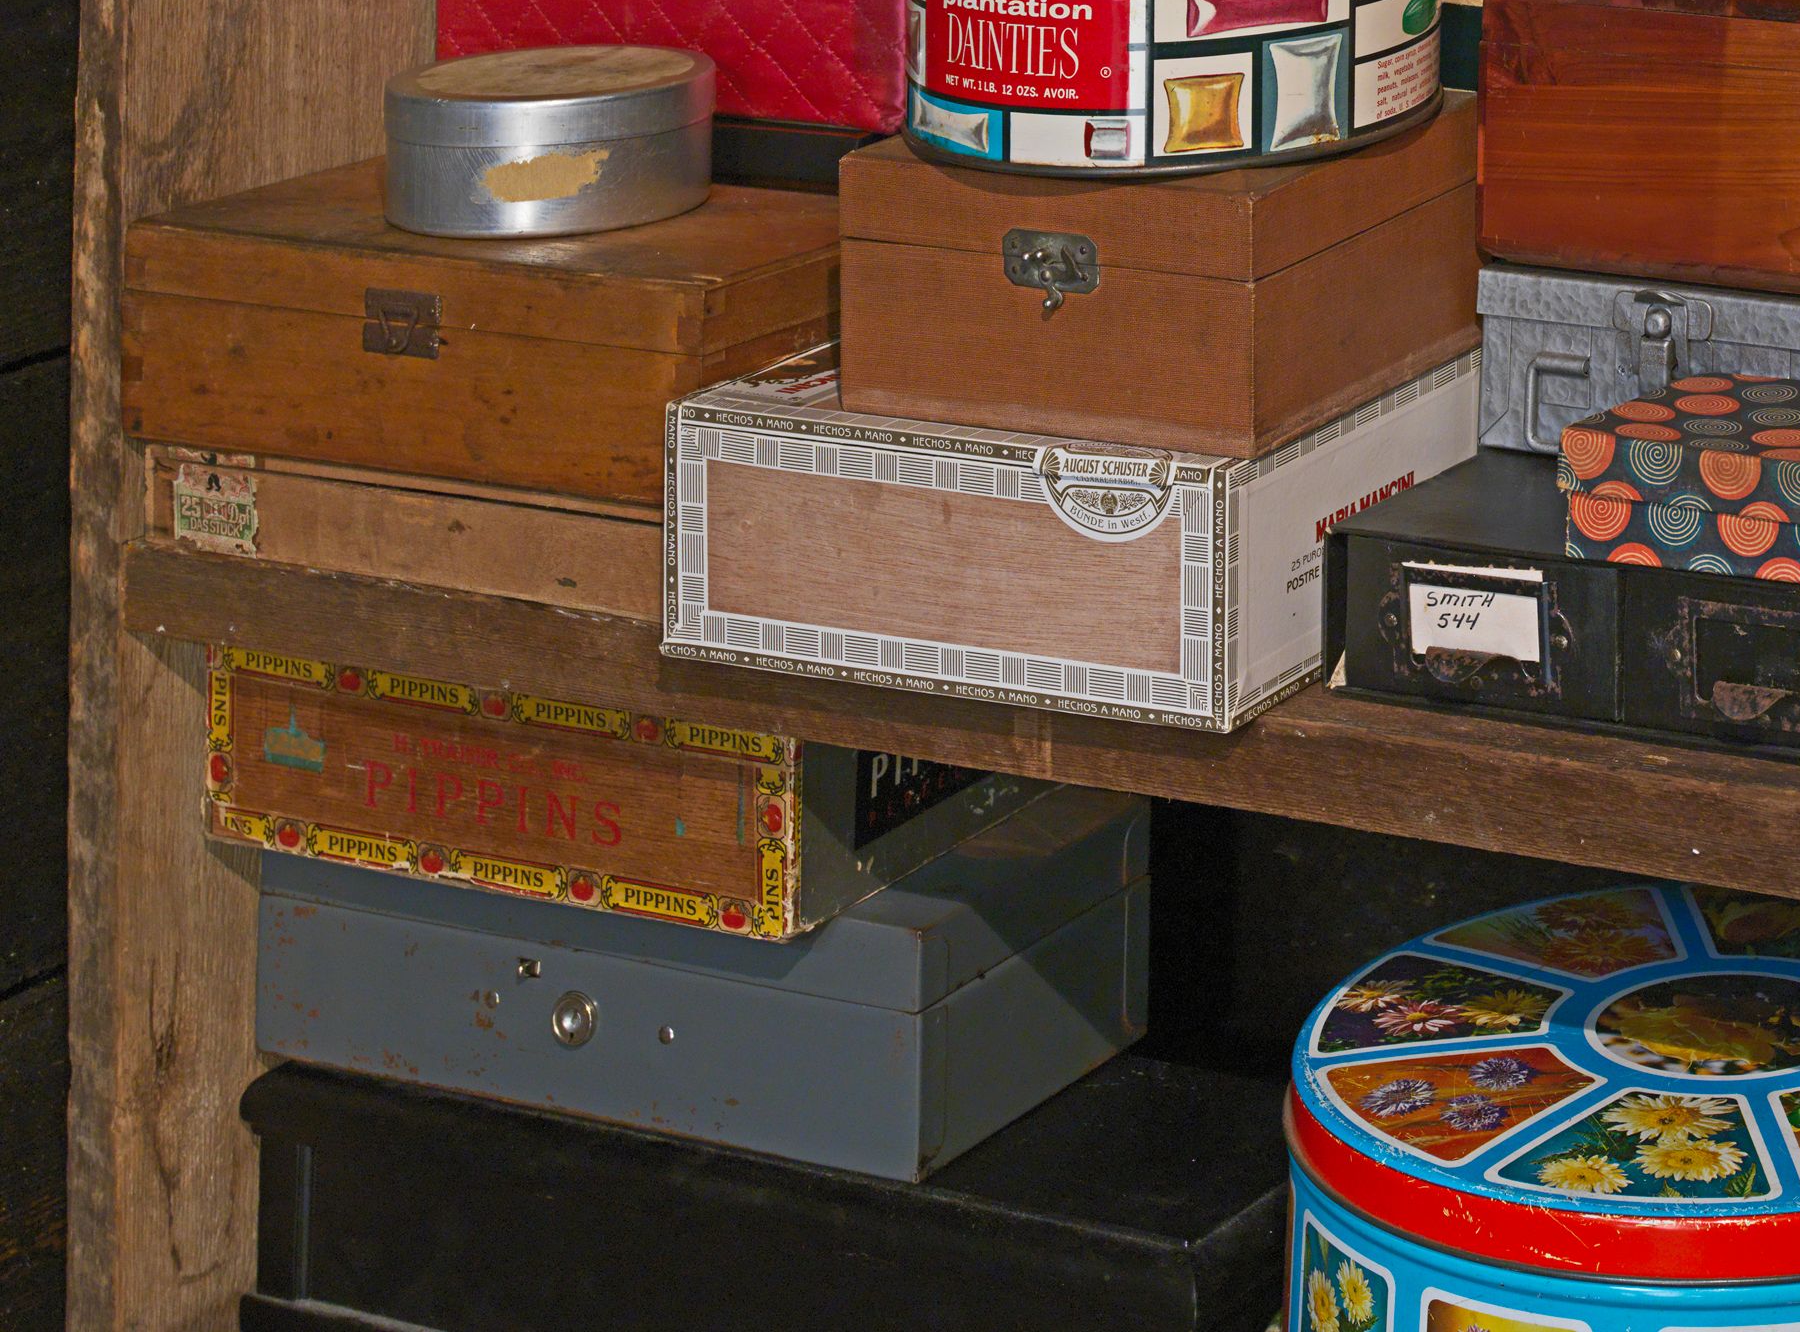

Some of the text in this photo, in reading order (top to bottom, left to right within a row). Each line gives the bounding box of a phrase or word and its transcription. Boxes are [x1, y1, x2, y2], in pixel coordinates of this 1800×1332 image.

[946, 13, 1081, 80] DAINTIES
[945, 74, 959, 86] NET
[962, 77, 977, 89] WT.
[983, 81, 998, 94] LB.
[1002, 84, 1013, 95] 12
[1016, 85, 1039, 97] OZS.
[1043, 87, 1080, 100] AVOIR.
[715, 412, 795, 431] HECHOS A MANO
[812, 424, 893, 443] HECHOS A MANO
[911, 436, 994, 456] HECHOS A MANO
[1062, 457, 1149, 478] AUGUST SCHUSTER
[182, 495, 201, 517] 25
[190, 517, 209, 532] DAS
[1107, 521, 1117, 530] in
[1290, 560, 1301, 573] 25
[1286, 566, 1321, 594] POSTRE
[1426, 590, 1496, 610] SMITH
[1436, 612, 1480, 631] 544
[244, 652, 313, 679] PIPPINS
[388, 678, 460, 705] PIPPINS
[534, 701, 608, 728] PIPPINS
[688, 726, 763, 754] PIPPINS
[363, 760, 624, 848] PIPPINS
[327, 835, 399, 864] PIPPINS
[472, 861, 545, 889] PIPPINS
[623, 887, 698, 916] PIPPINS
